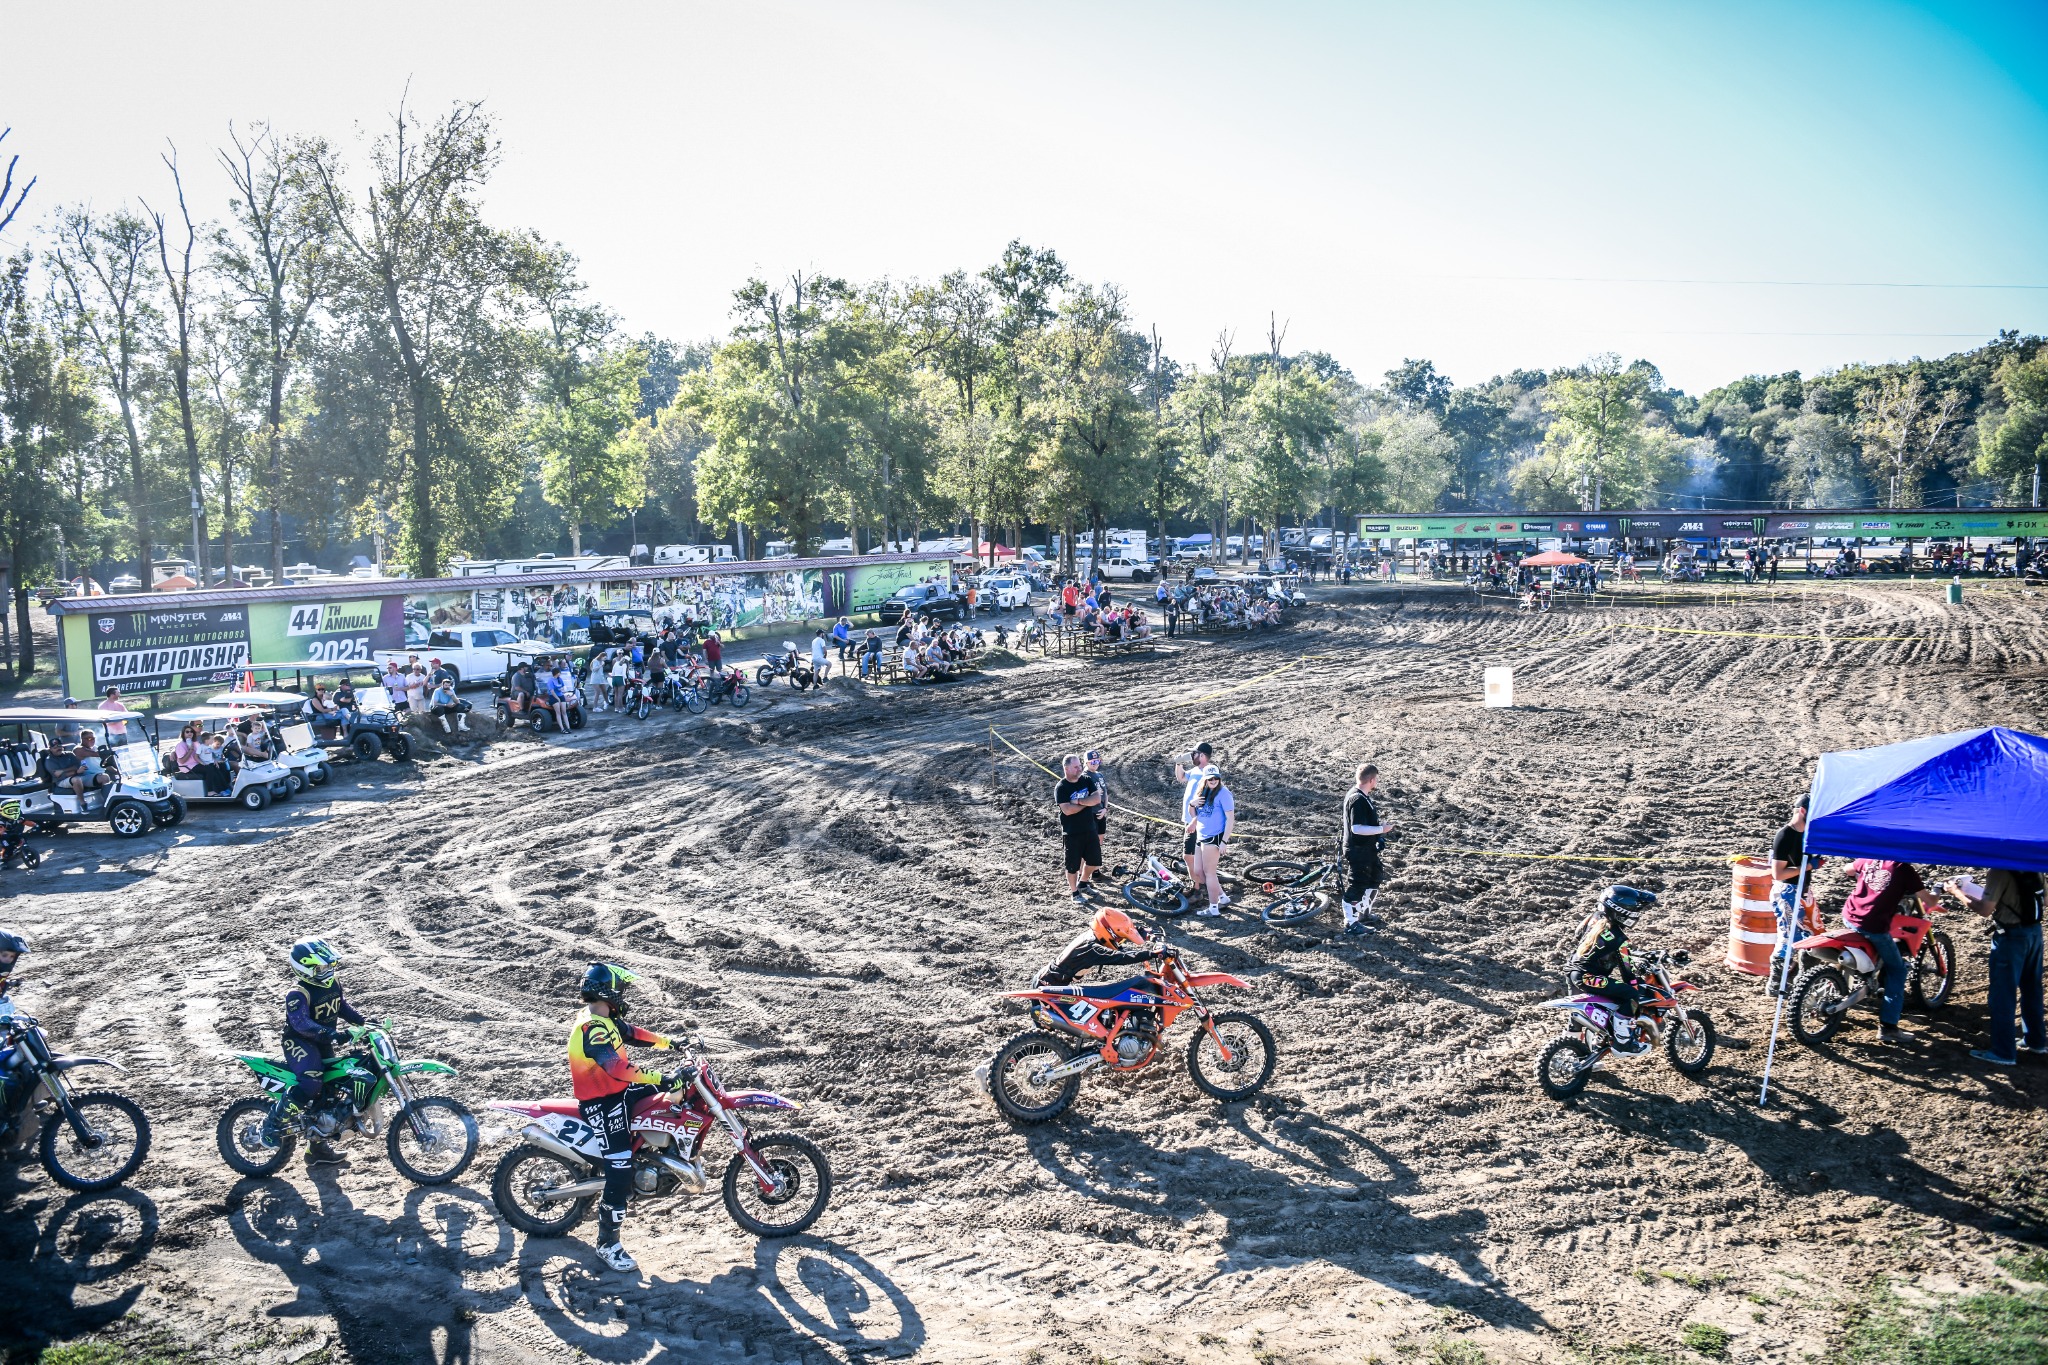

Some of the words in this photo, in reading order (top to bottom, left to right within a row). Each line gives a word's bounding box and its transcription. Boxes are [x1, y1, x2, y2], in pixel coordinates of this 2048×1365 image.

[151, 612, 207, 624] MONSTER
[220, 612, 243, 622] AMA
[291, 608, 319, 631] 44
[328, 605, 342, 616] TH
[324, 614, 374, 631] ANNUAL
[98, 638, 142, 650] AMATEUR
[146, 634, 189, 646] NATIONAL
[194, 629, 245, 642] MOTOCROSS
[308, 637, 370, 661] 2025
[100, 644, 246, 678] CHAMPIONSHIP
[1605, 899, 1632, 916] SCOTT
[284, 1039, 308, 1062] FXR
[260, 1076, 286, 1093] 17
[559, 1119, 595, 1148] 27
[630, 1115, 700, 1137] GASGAS
